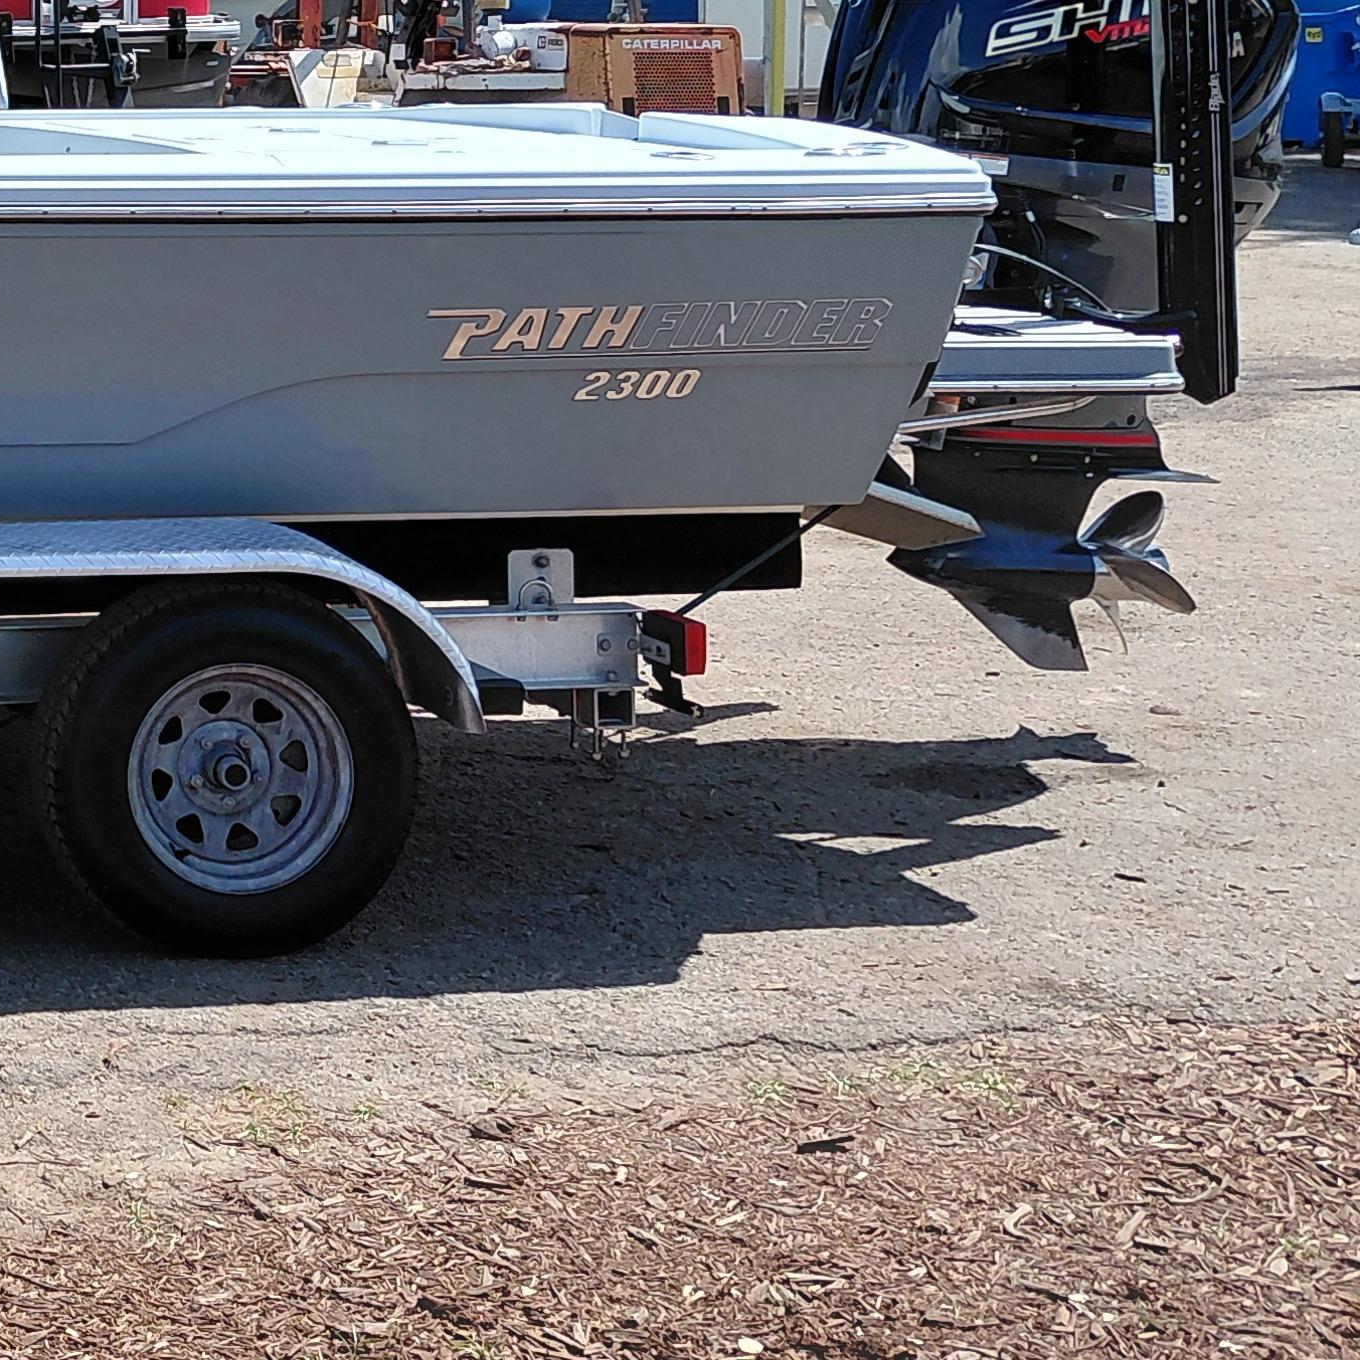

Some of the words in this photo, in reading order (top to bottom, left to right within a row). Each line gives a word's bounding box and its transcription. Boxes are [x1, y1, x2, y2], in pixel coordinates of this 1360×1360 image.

[622, 39, 722, 50] CATERPILLAR
[1208, 72, 1226, 111] Blade
[427, 298, 894, 361] PATHFINDER
[573, 368, 703, 401] 2300
